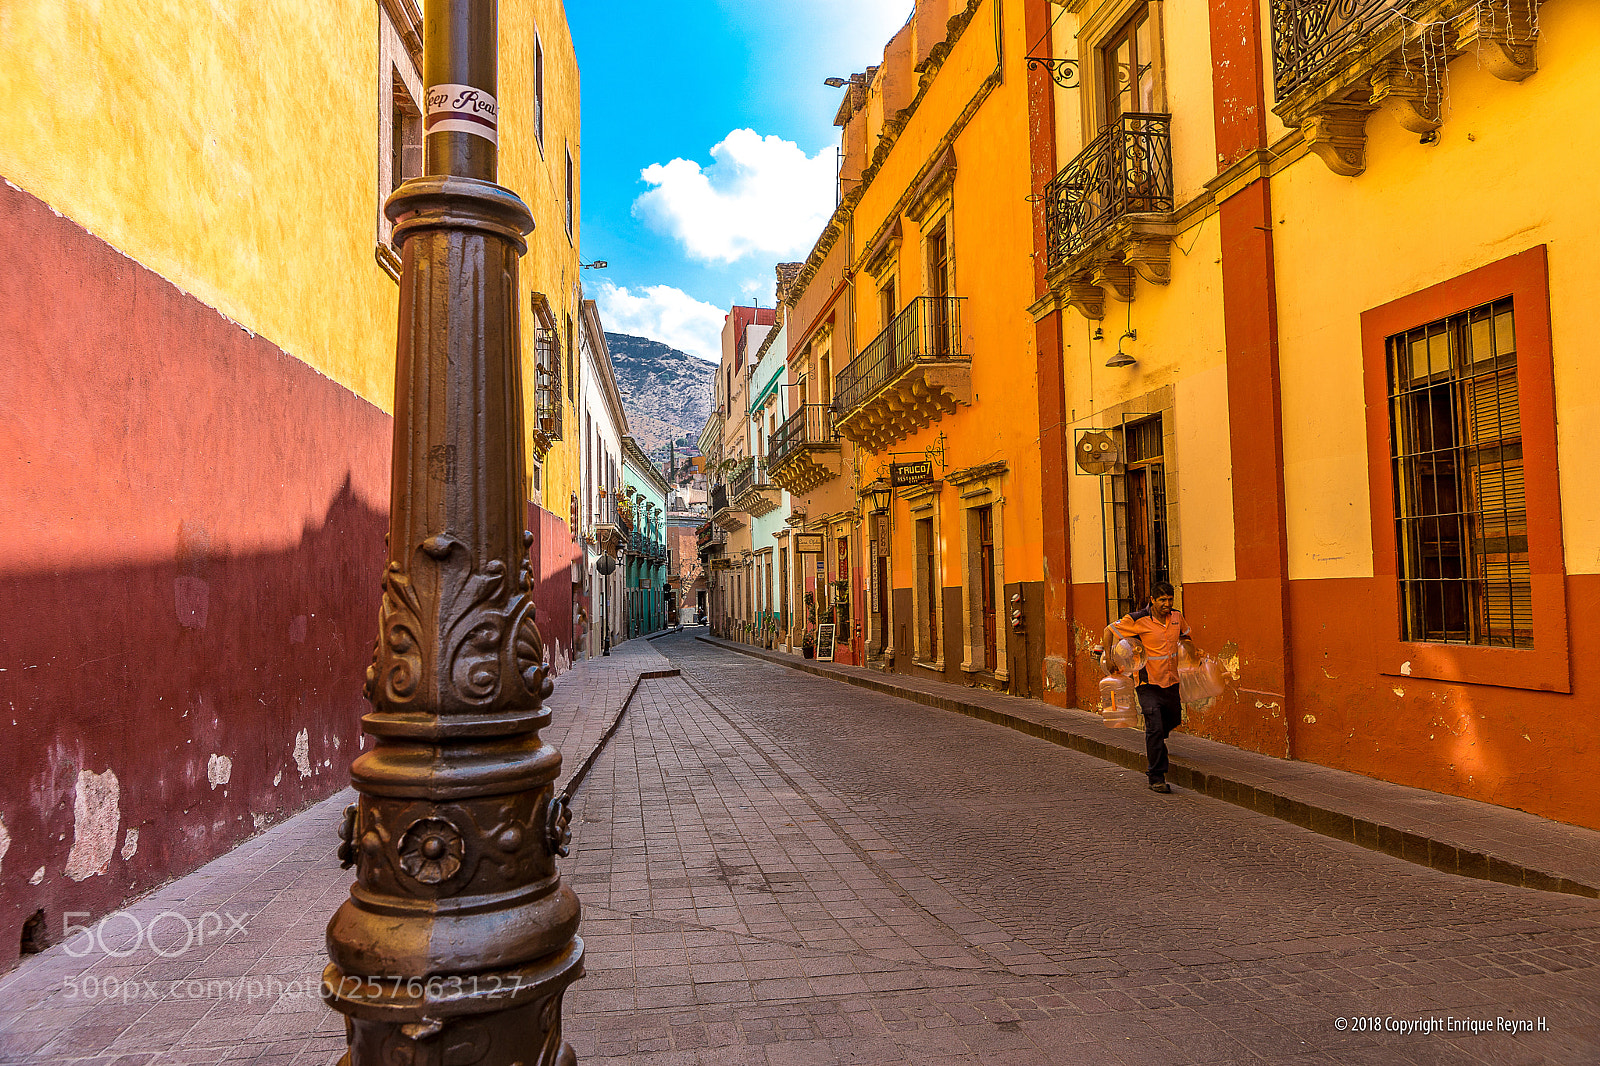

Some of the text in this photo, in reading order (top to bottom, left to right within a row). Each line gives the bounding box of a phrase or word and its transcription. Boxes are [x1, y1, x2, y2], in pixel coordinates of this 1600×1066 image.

[452, 90, 496, 116] Real
[898, 462, 931, 475] TRUCO 7
